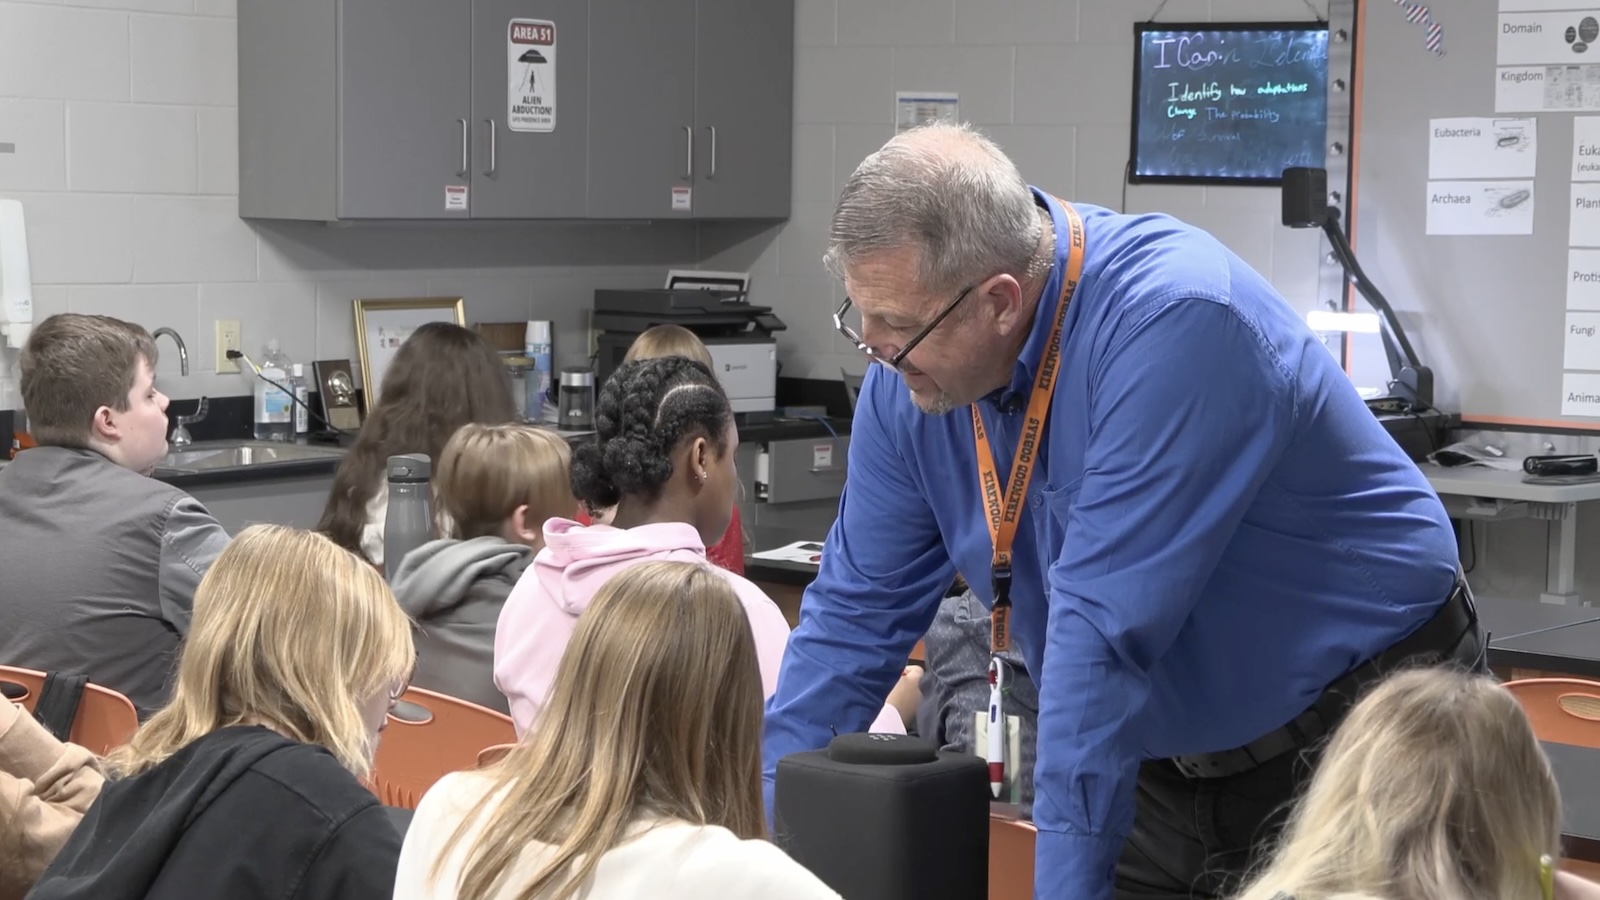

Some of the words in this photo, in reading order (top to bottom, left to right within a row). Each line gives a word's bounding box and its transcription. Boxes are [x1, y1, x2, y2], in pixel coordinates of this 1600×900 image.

[513, 26, 538, 40] AREA
[541, 28, 551, 41] 51
[1503, 22, 1542, 34] Domain
[1152, 39, 1176, 69] I
[1501, 71, 1543, 84] Kingdom
[1167, 82, 1222, 102] Identify
[1230, 84, 1246, 96] how
[522, 95, 542, 105] ALIEN
[512, 105, 552, 115] ABDUCTION!
[1205, 107, 1227, 121] The
[1434, 127, 1481, 138] Eubacteria
[1431, 193, 1471, 204] Archaea
[1039, 329, 1061, 391] KIRKWOOD
[1057, 279, 1076, 328] COBRAS
[1570, 325, 1596, 337] Fungi
[1004, 464, 1029, 523] KIRKWOOD
[1019, 417, 1040, 464] COBRAS
